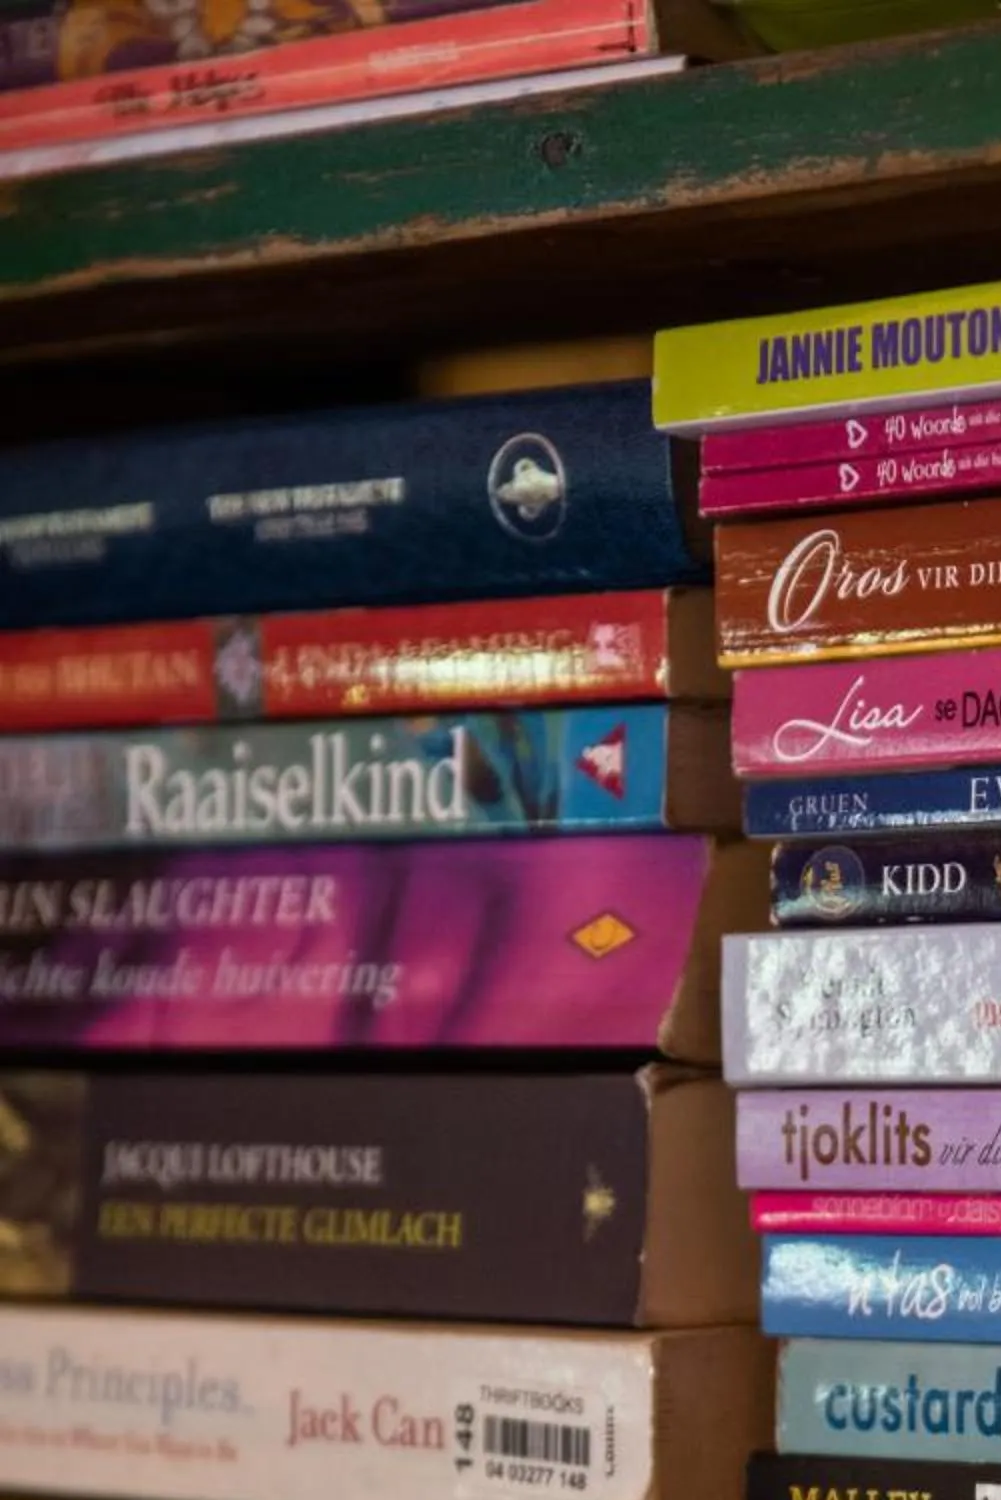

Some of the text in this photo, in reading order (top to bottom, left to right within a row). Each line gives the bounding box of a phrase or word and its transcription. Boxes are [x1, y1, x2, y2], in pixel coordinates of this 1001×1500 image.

[756, 326, 863, 385] JANNIE
[885, 415, 907, 444] 40
[877, 459, 898, 485] 40
[768, 529, 909, 633] Oros
[919, 567, 959, 590] VIR
[773, 674, 923, 764] Lisa
[934, 700, 957, 723] se
[124, 726, 470, 836] Raaiselkind
[789, 792, 868, 816] GRUEN
[70, 874, 338, 928] SLAUGHTER
[881, 863, 968, 898] KIDD
[215, 950, 404, 1009] huivering
[103, 1140, 383, 1188] JACQUI LOFTHOUSE
[782, 1102, 932, 1180] tjoklits
[939, 1137, 976, 1166] vir
[303, 1207, 462, 1248] GLIMLACH
[285, 1388, 361, 1449] Jack
[454, 1403, 475, 1473] 148
[560, 1471, 588, 1490] 148
